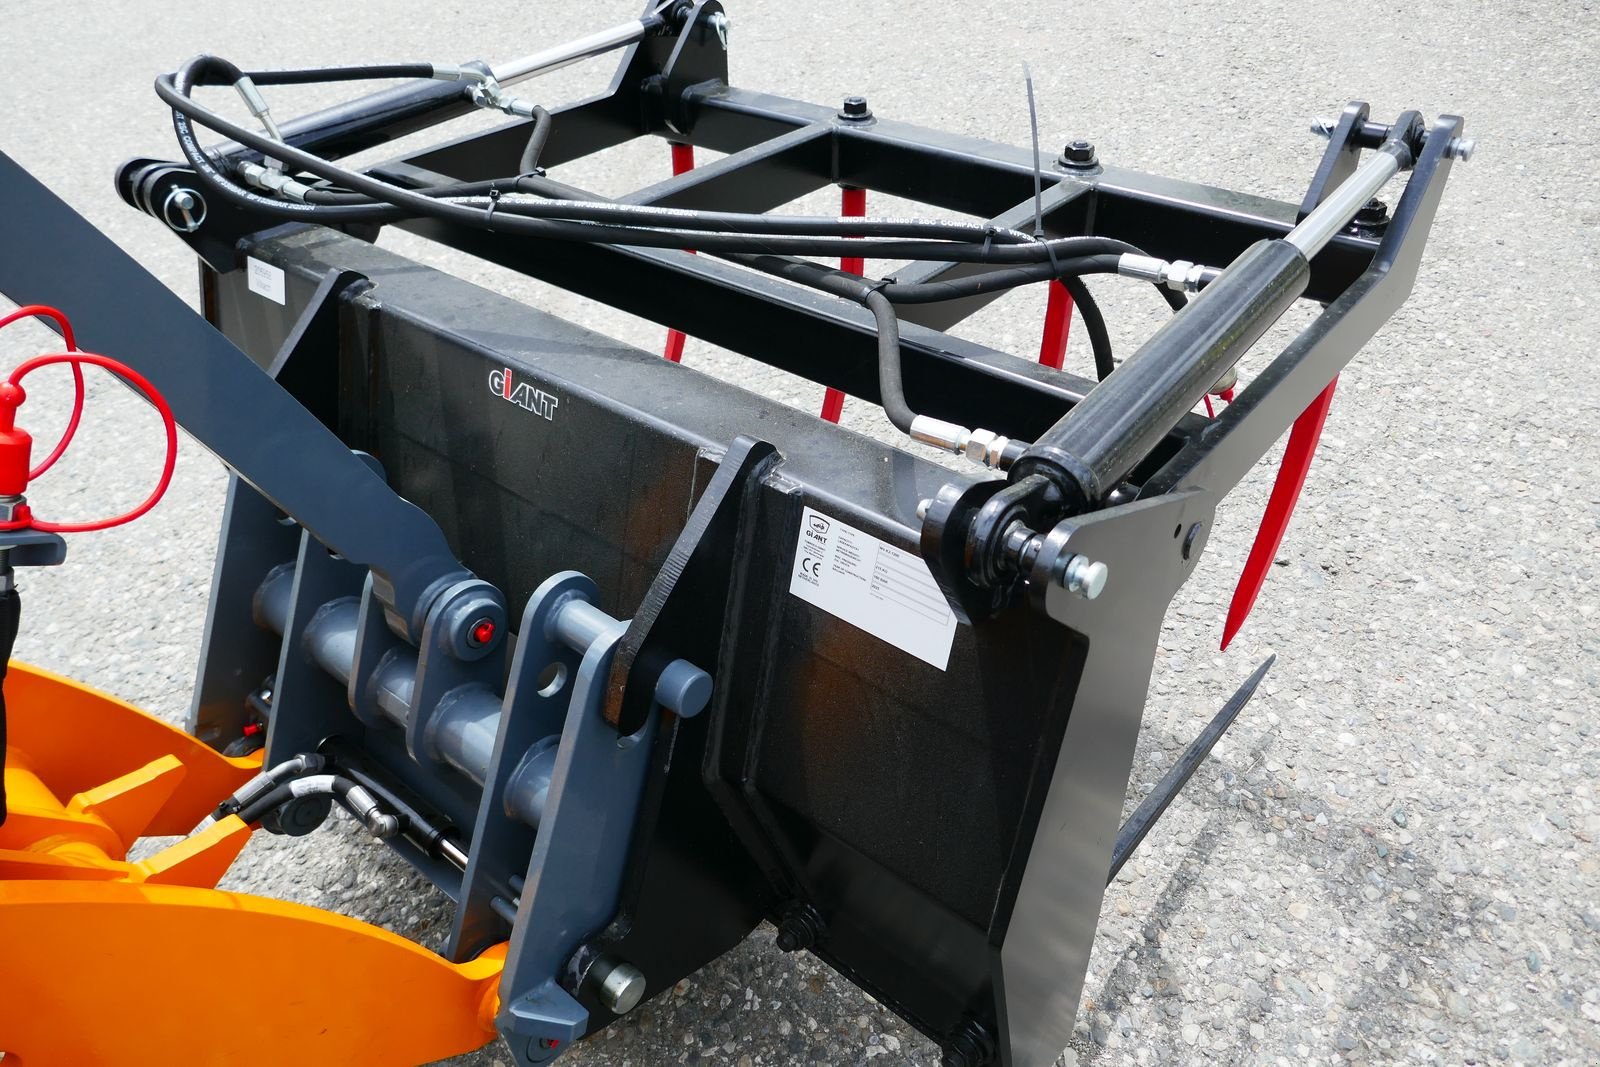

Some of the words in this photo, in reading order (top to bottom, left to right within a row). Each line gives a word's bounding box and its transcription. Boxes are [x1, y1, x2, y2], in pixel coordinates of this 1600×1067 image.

[183, 136, 206, 164] COMPACT
[515, 198, 552, 206] COMPACT
[837, 216, 882, 224] SINOFLEX
[940, 219, 985, 230] COMPACT
